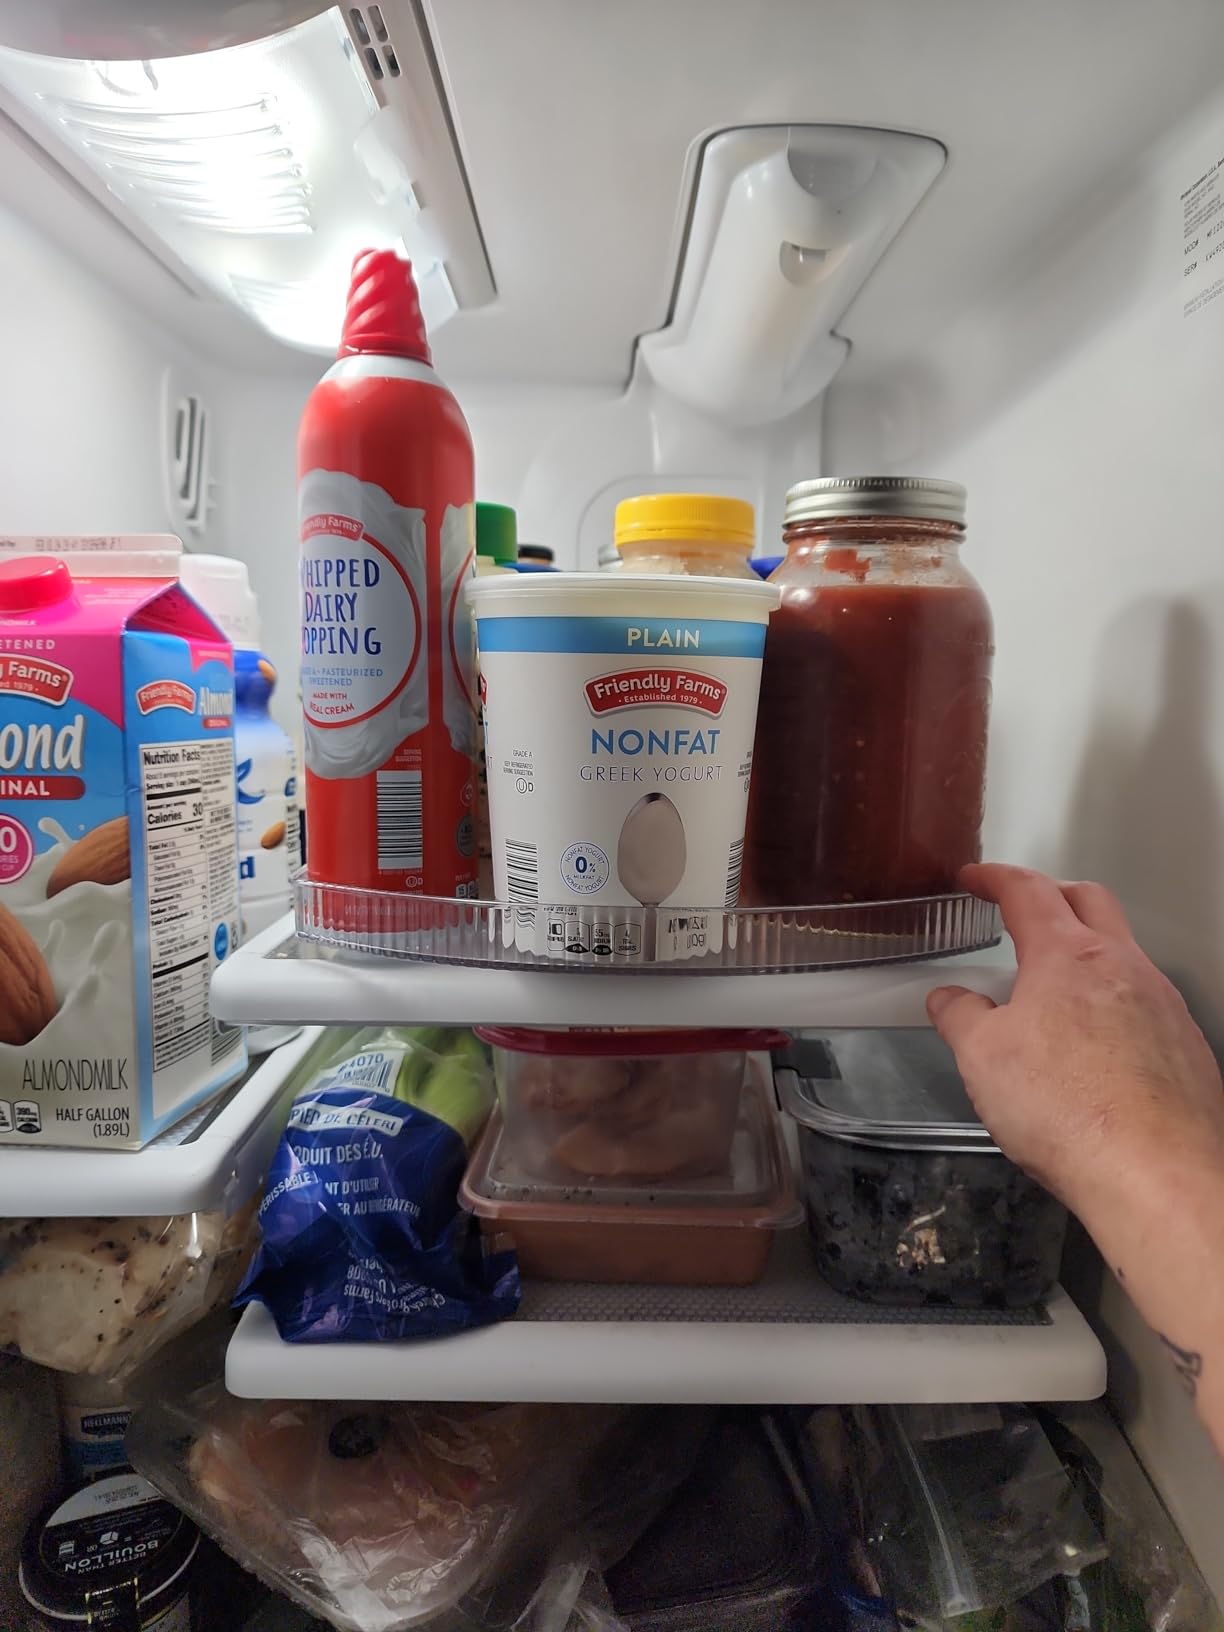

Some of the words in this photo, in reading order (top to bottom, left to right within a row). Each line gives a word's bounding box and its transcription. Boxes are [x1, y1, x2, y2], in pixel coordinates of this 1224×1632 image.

[303, 558, 381, 588] HIPPED
[304, 591, 358, 622] DAIRY
[302, 626, 382, 656] OPPING
[627, 627, 700, 648] PLAIN
[8, 661, 62, 688] Farms
[329, 692, 347, 700] WITH
[593, 673, 671, 699] Friendly
[675, 675, 722, 700] Farms
[324, 702, 356, 715] CREAM
[624, 693, 677, 703] Established
[680, 694, 698, 704] 1979
[590, 728, 721, 756] NONFAT
[143, 750, 180, 766] Nutrition
[181, 747, 201, 762] Facts
[580, 765, 644, 782] GREEK
[653, 765, 723, 782] YOGURT
[147, 811, 183, 825] Calories
[193, 802, 204, 817] 30
[575, 856, 596, 873] 0%
[585, 846, 605, 864] YOGURT
[22, 1057, 129, 1091] ALMONDMILK
[56, 1107, 84, 1121] HALF
[86, 1107, 130, 1121] GALLON
[290, 1107, 321, 1126] PIED
[93, 1122, 130, 1138] (1.89L)
[336, 1142, 362, 1164] DES
[353, 1200, 368, 1215] AU
[343, 1284, 374, 1304] Farms
[64, 1539, 159, 1572] BOUILLON
